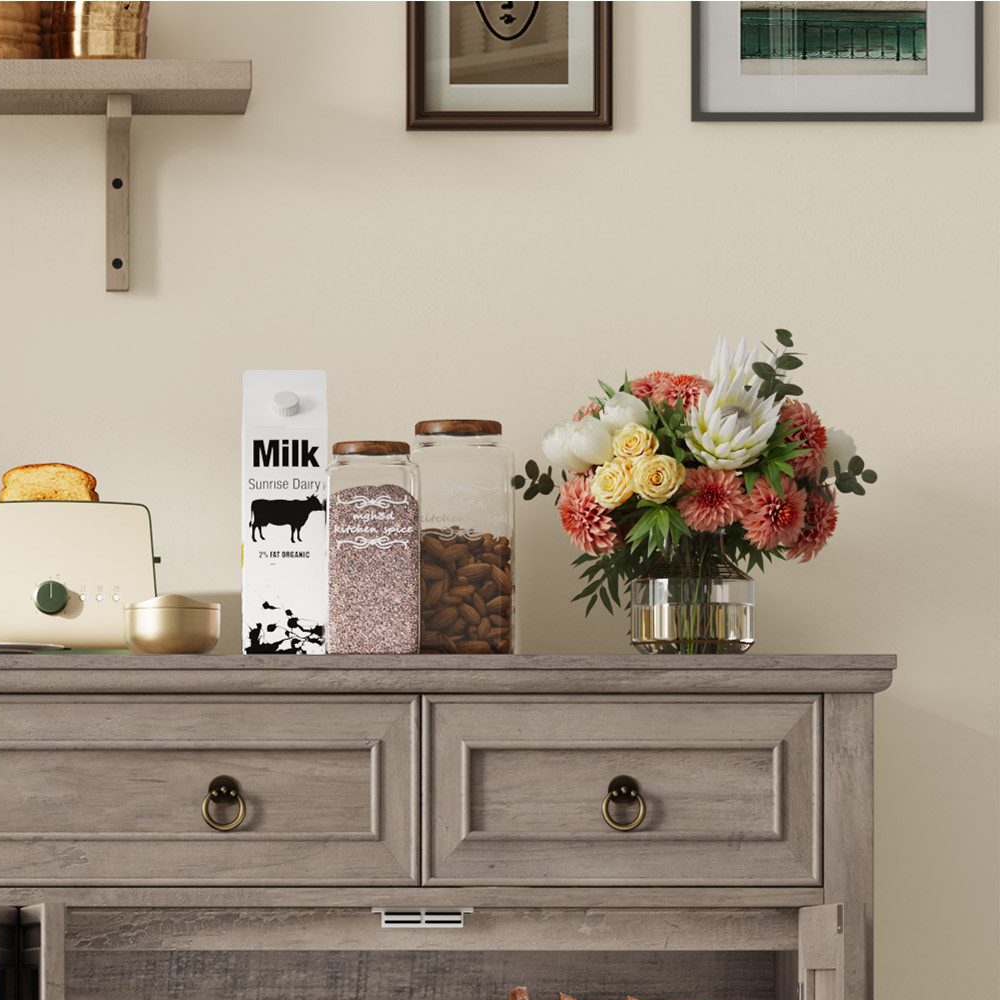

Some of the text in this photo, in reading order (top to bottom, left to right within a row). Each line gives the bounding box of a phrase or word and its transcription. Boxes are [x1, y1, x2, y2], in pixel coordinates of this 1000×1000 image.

[253, 439, 320, 467] Milk
[248, 478, 321, 492] Sunrise Dairy
[269, 551, 280, 559] FAT
[281, 551, 310, 559] ORGANIC
